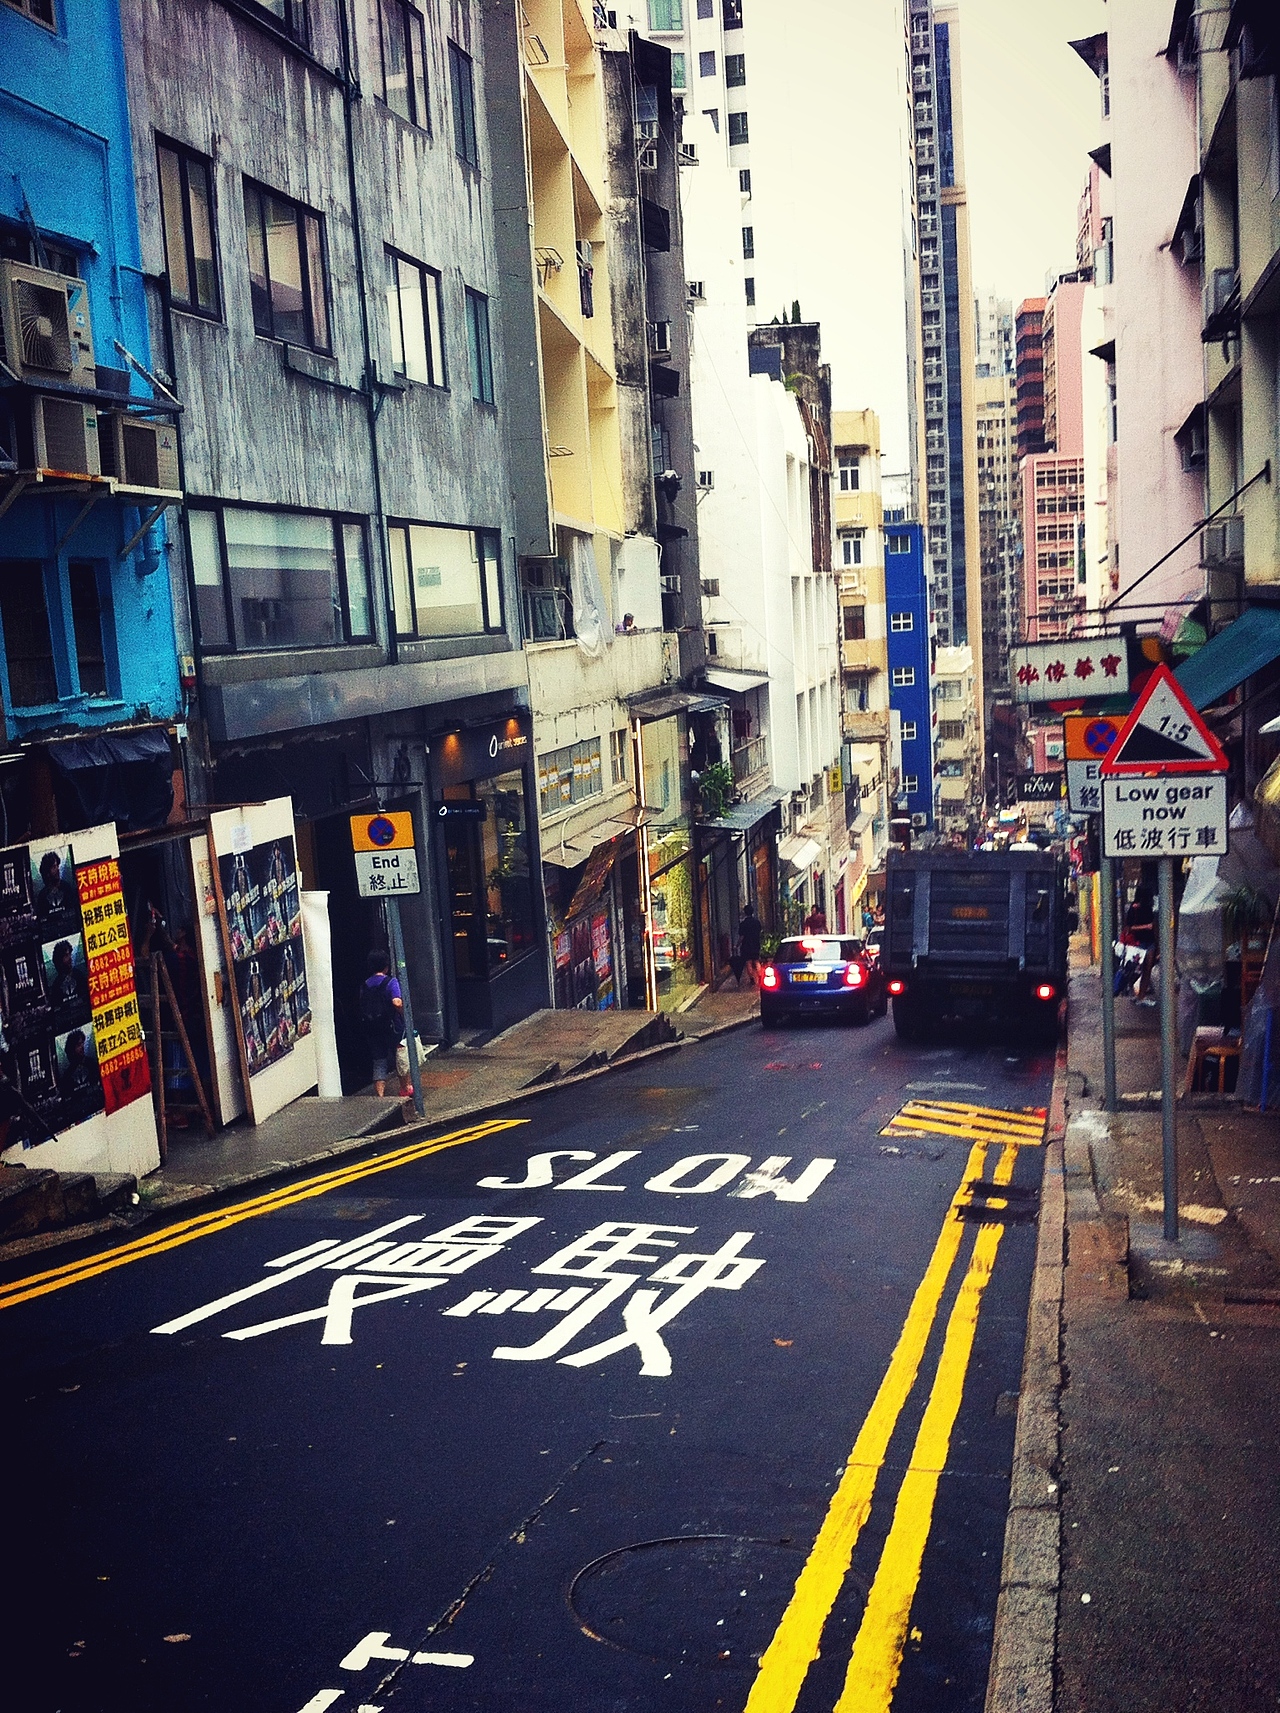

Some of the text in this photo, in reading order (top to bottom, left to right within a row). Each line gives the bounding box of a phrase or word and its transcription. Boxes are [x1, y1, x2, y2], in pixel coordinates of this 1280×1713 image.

[1160, 715, 1192, 742] 1:5
[1024, 777, 1055, 793] RAW
[1116, 785, 1213, 804] Low gear
[1143, 806, 1186, 820] now
[1114, 826, 1218, 849] 低波行車
[372, 855, 400, 869] End
[368, 873, 408, 891] 終止
[87, 922, 128, 952] 成立公司
[477, 1150, 836, 1203] SLOW
[150, 1214, 766, 1376] 慢駛
